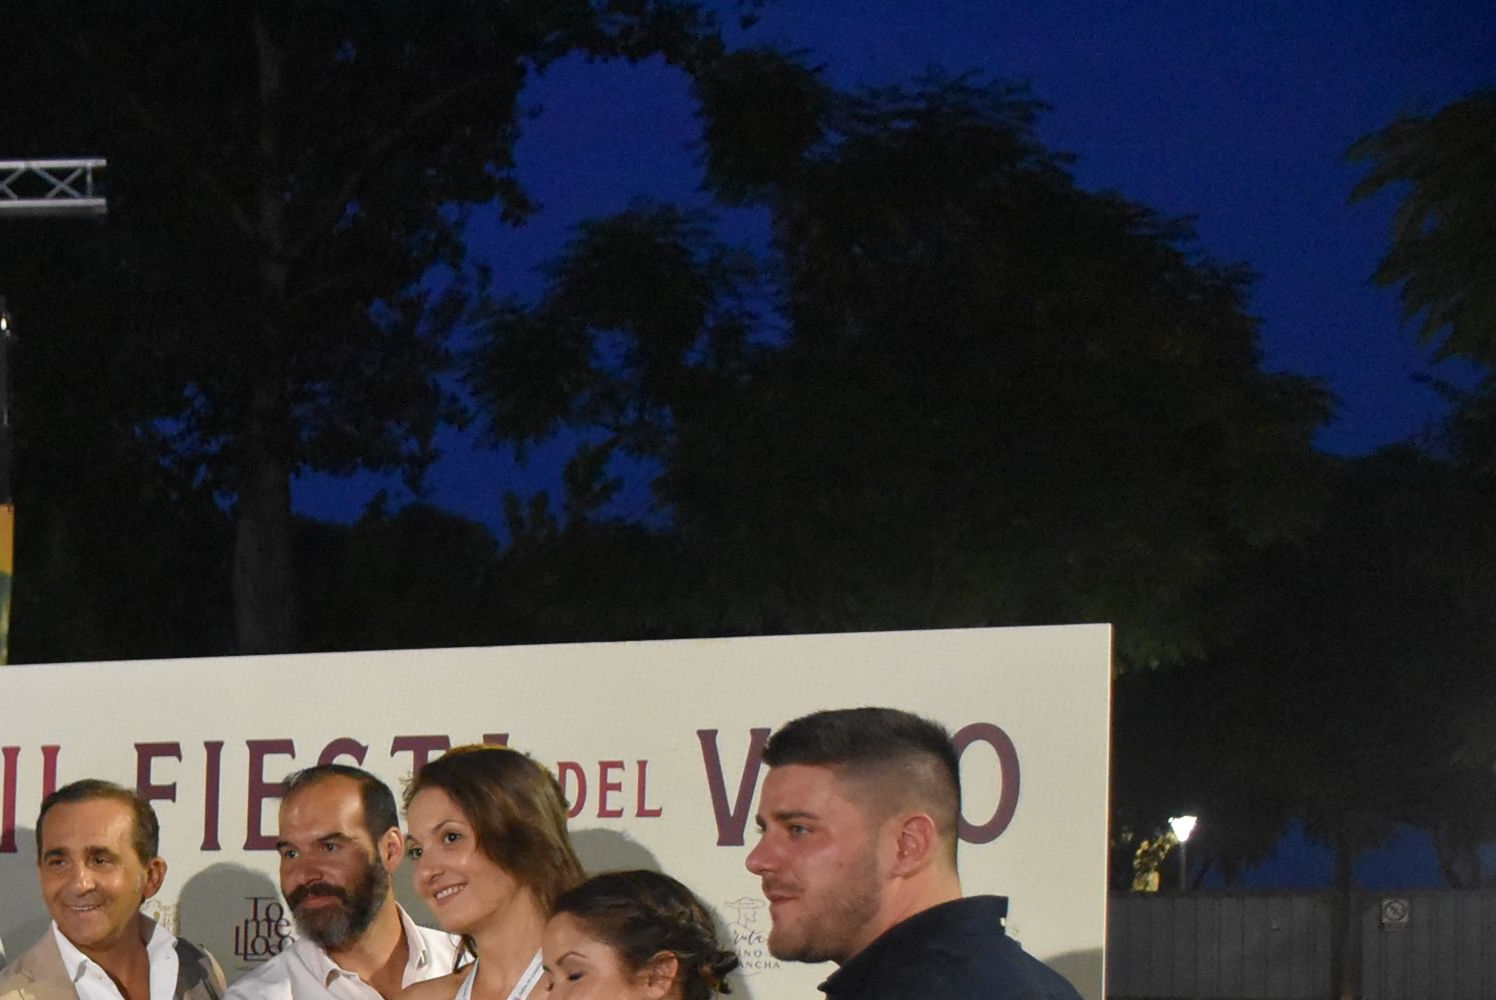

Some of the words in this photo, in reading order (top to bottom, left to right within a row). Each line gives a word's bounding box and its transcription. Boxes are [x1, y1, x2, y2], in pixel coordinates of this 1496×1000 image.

[134, 733, 509, 851] FIET
[557, 760, 663, 818] DEL
[697, 722, 1020, 847] VO
[737, 949, 762, 958] INO
[738, 960, 781, 969] ANCHA
